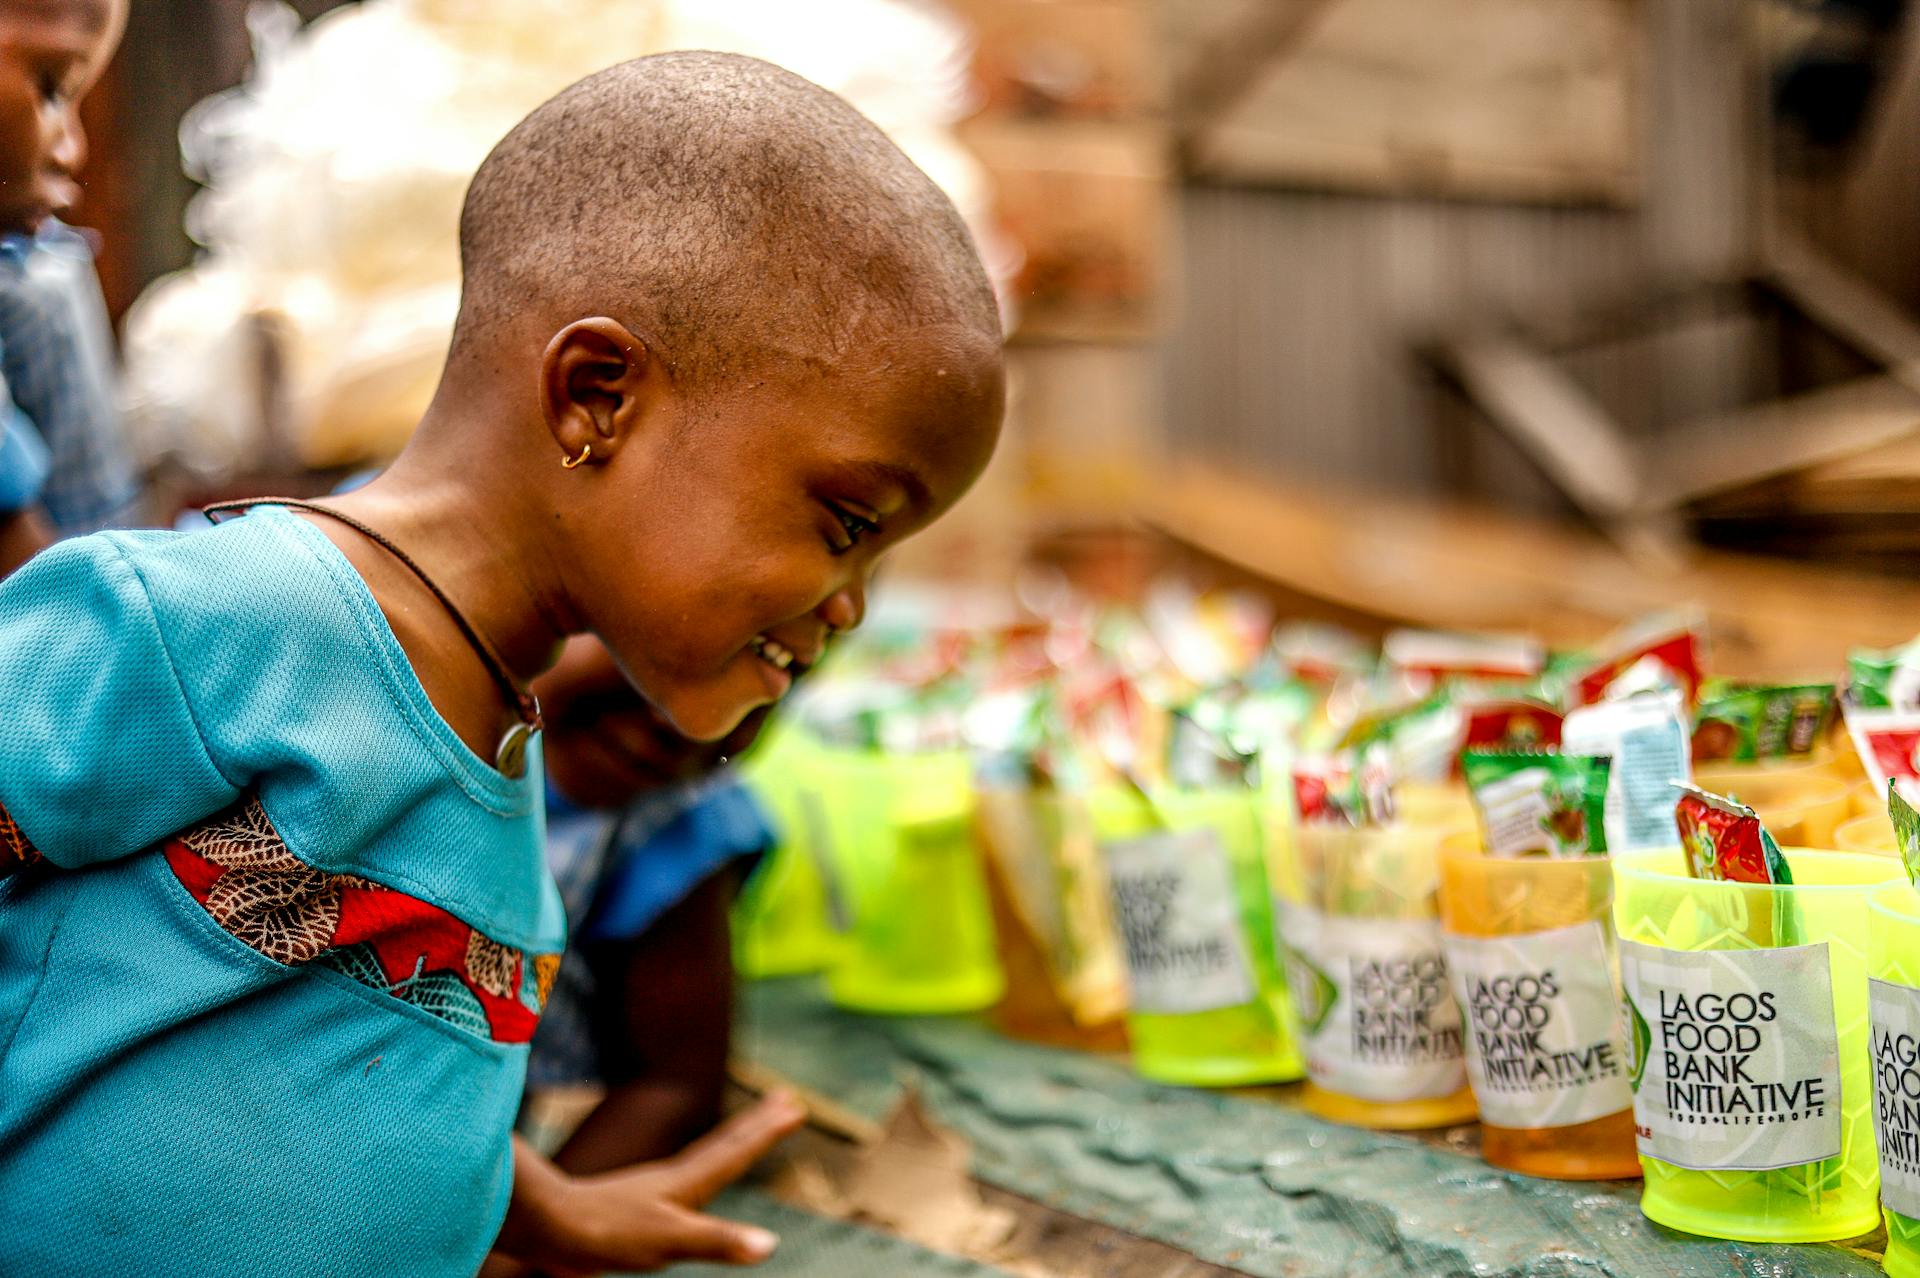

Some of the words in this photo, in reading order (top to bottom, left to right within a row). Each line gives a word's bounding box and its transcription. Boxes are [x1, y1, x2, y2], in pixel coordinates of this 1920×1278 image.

[1471, 1003, 1550, 1031] FOOD
[1659, 989, 1777, 1023] LAGOS
[1475, 1030, 1549, 1059] BANK
[1660, 1020, 1762, 1054] FOOD
[1872, 1025, 1920, 1067] LAG
[1480, 1042, 1618, 1084] INITIATIVE
[1664, 1050, 1755, 1084] BANK
[1665, 1077, 1825, 1114] INITIATIVE
